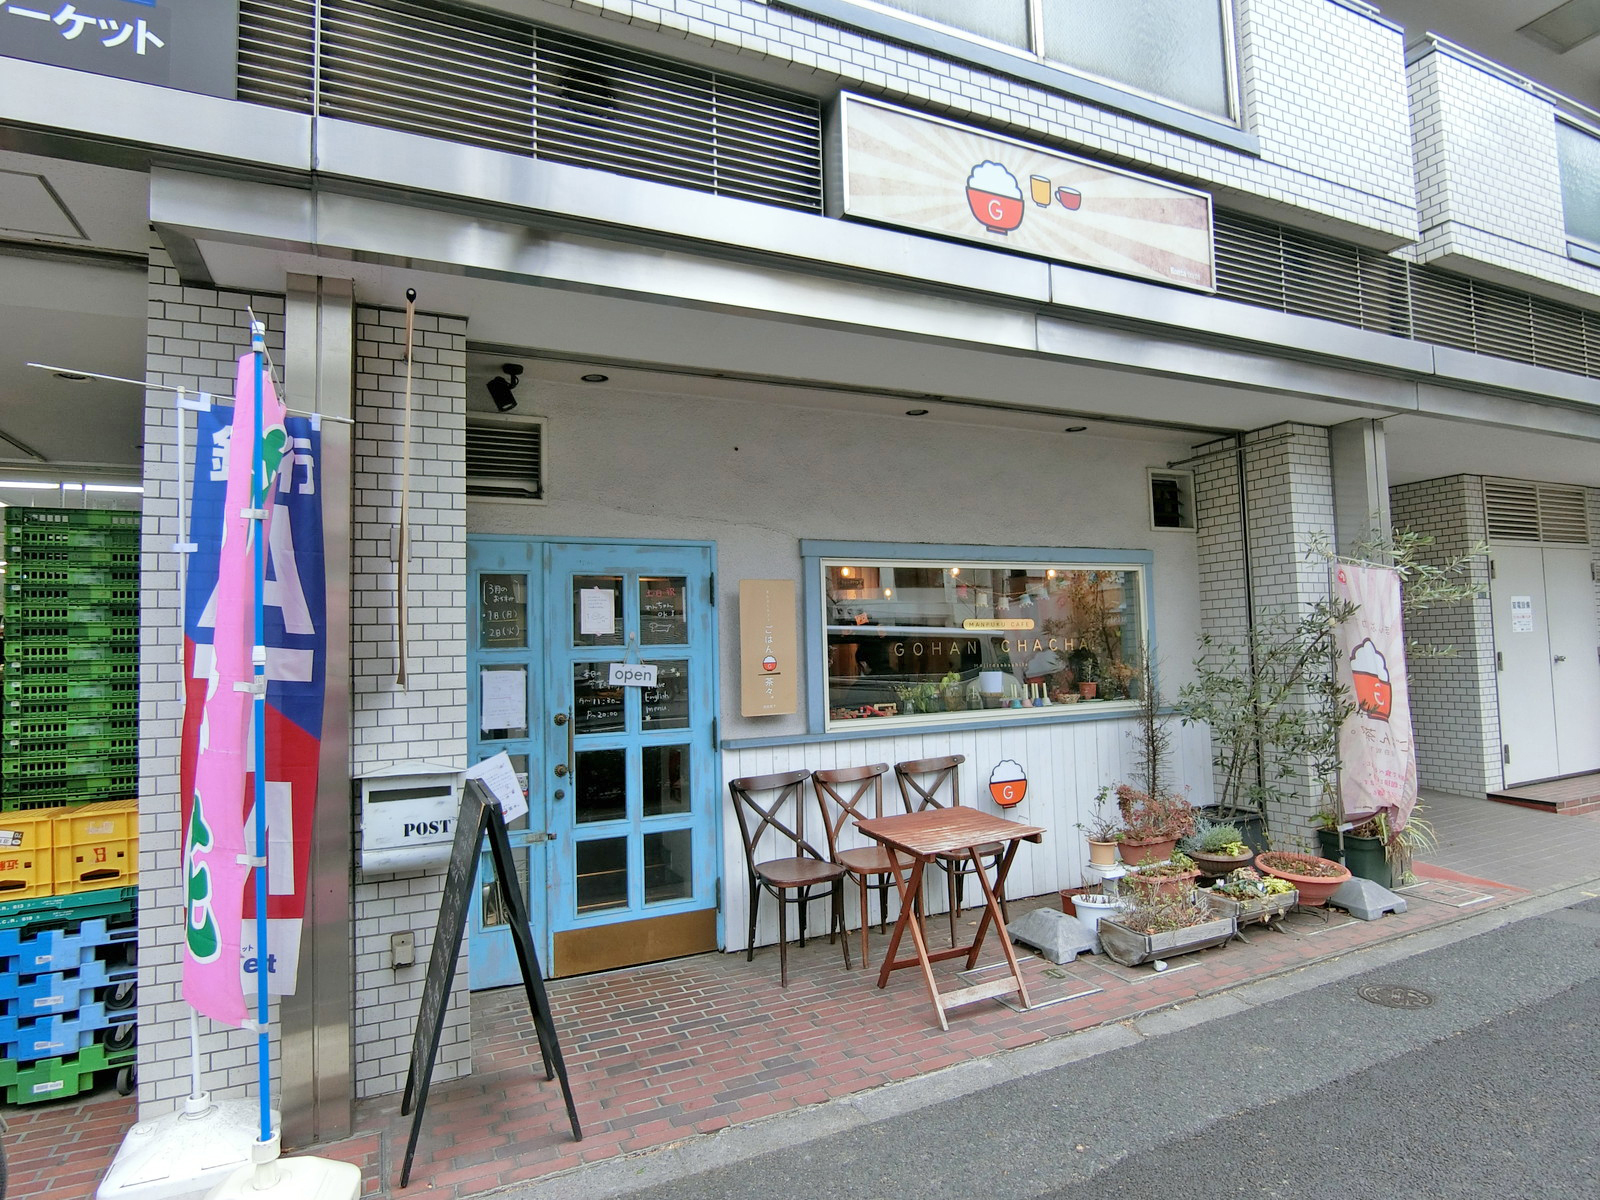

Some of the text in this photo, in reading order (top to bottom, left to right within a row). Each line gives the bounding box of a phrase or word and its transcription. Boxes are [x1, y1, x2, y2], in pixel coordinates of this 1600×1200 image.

[0, 0, 165, 55] ーケット
[987, 199, 1004, 221] G
[1010, 620, 1029, 628] CAFE
[893, 641, 977, 657] GOHAN
[614, 669, 652, 683] open
[1003, 785, 1014, 800] G
[403, 819, 452, 837] POST
